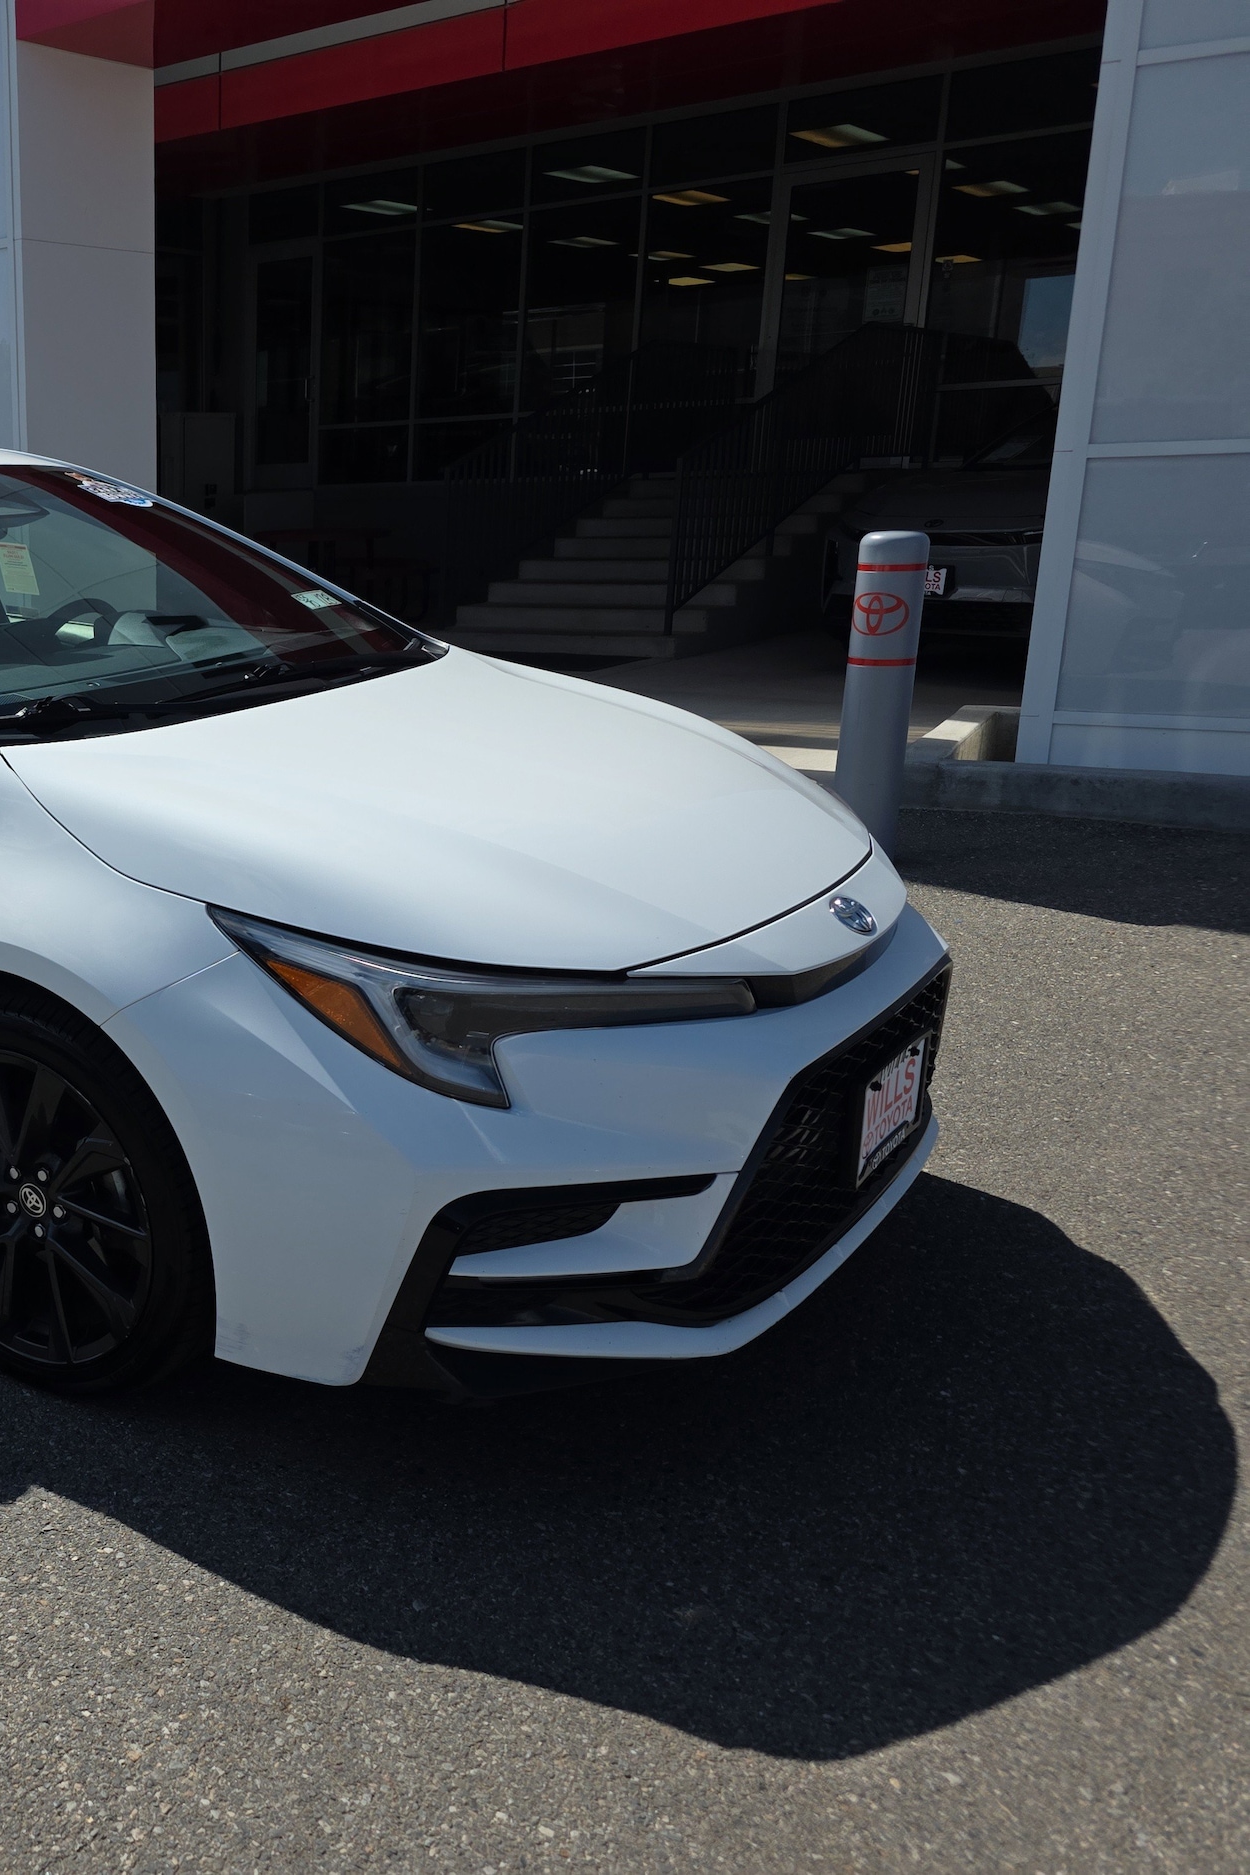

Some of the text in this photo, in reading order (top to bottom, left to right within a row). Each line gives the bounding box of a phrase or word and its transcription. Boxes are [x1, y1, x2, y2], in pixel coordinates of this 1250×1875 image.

[867, 1058, 916, 1131] WILLS
[873, 1095, 913, 1145] TOYOTA
[881, 1128, 906, 1160] TOYOTA
